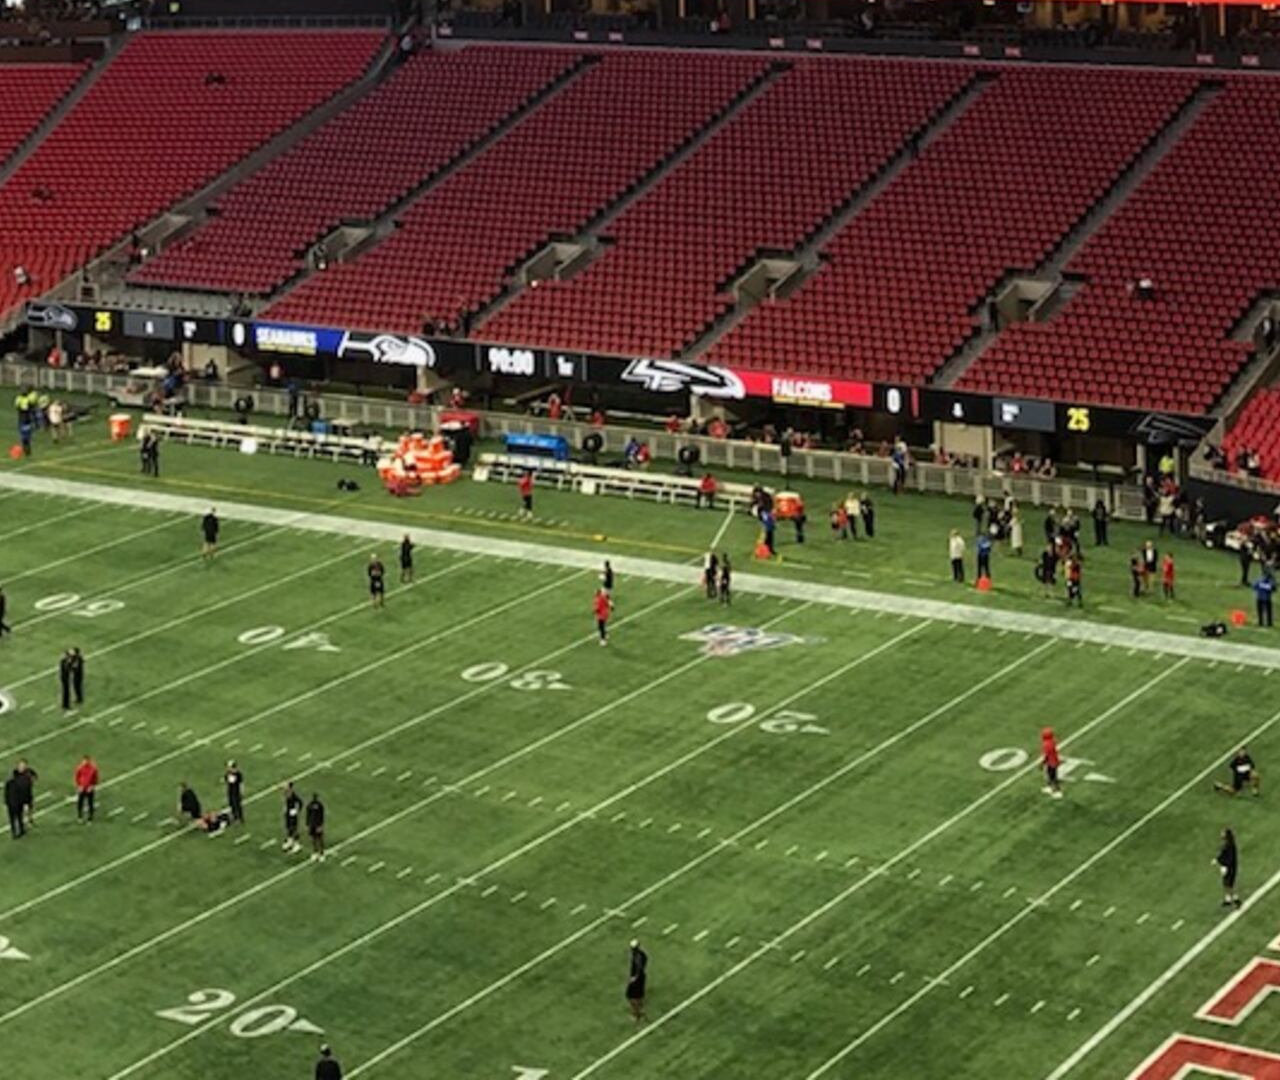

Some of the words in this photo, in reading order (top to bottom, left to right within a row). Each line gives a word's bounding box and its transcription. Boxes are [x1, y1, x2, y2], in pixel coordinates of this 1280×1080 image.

[233, 323, 244, 345] 0
[488, 348, 534, 375] 90:00
[887, 389, 900, 412] 0
[1067, 408, 1089, 430] 25
[154, 987, 298, 1038] 20
